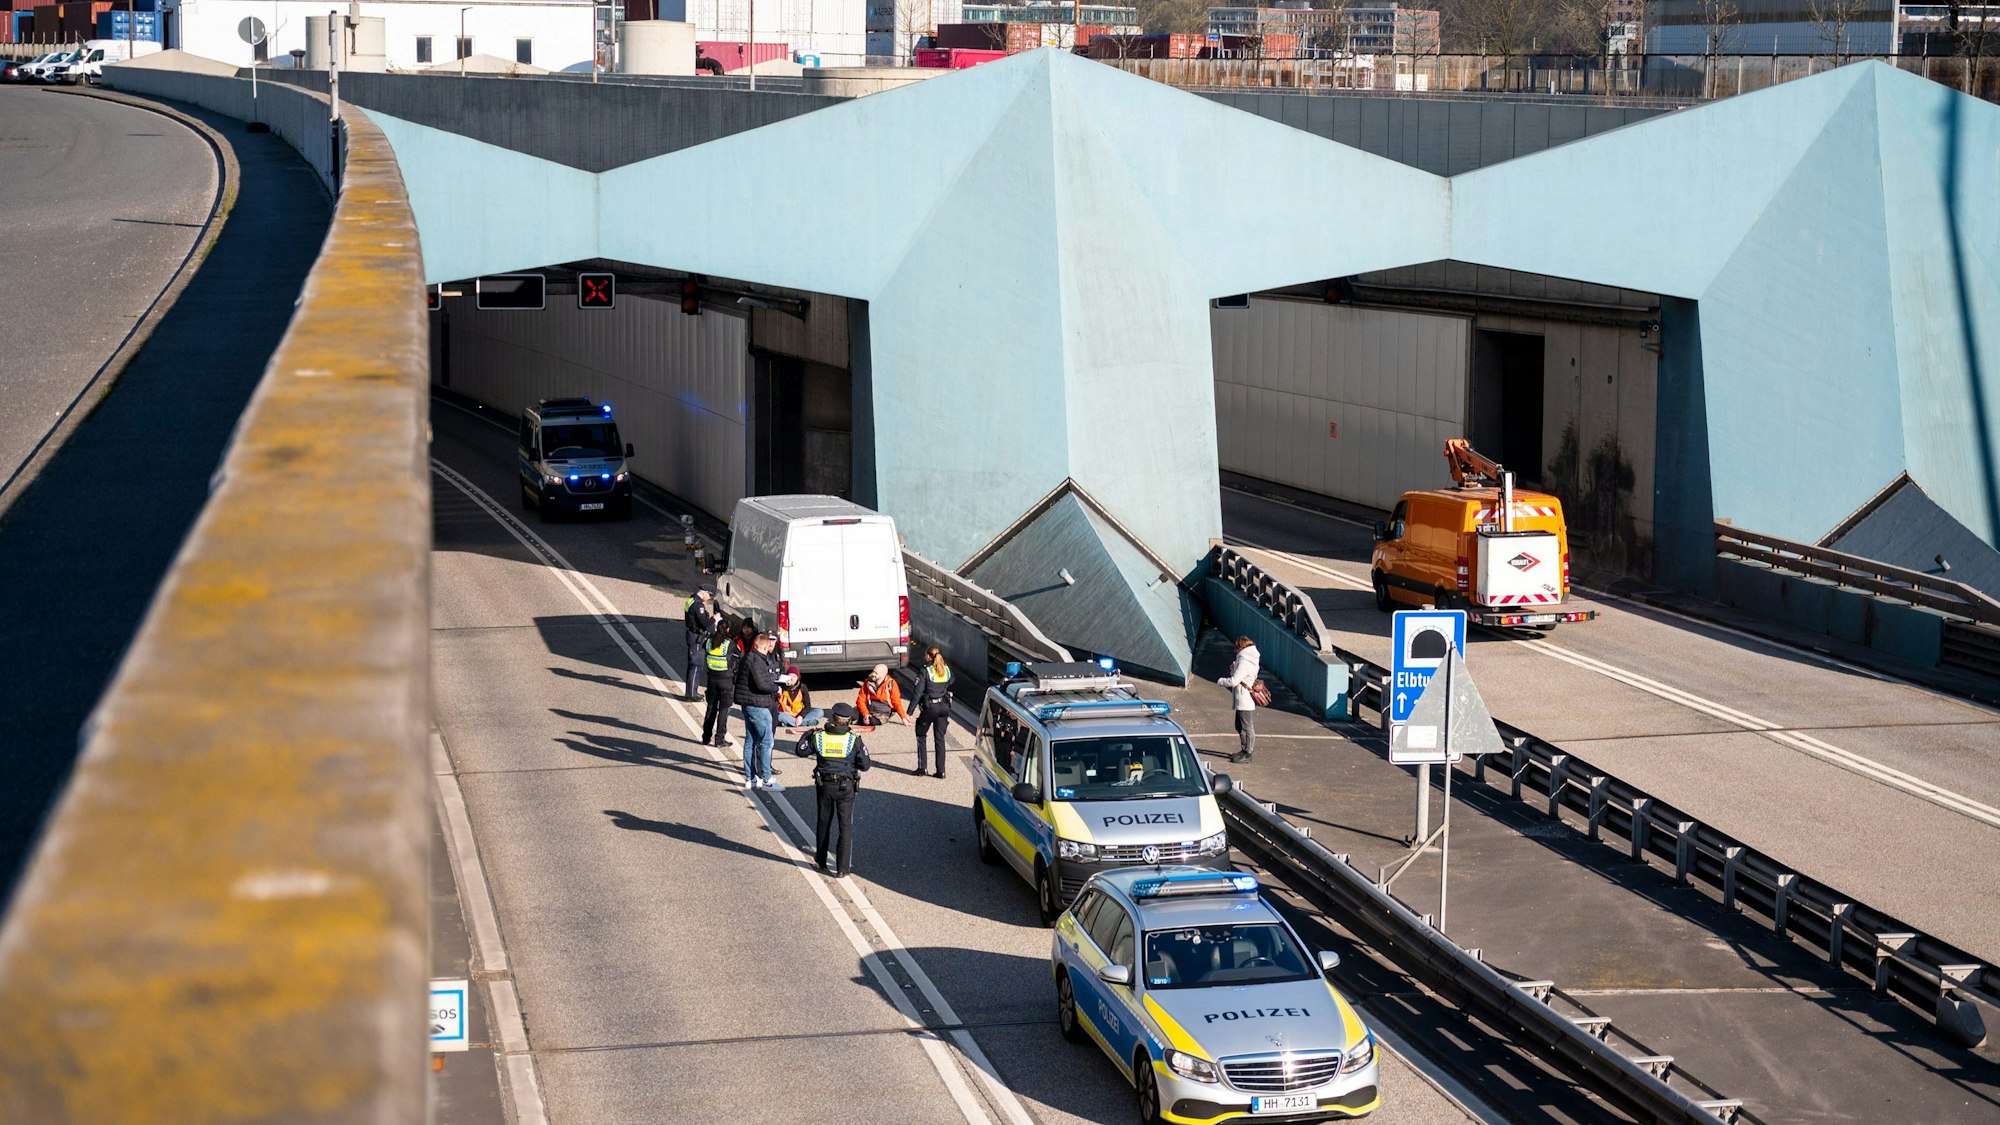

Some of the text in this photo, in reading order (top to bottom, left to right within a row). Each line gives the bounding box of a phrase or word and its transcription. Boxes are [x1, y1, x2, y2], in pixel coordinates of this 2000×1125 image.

[1103, 813, 1184, 827] POLIZEI
[1098, 998, 1120, 1036] POLIZEI
[1204, 1008, 1311, 1024] POLIZEI
[1264, 1096, 1310, 1109] HH 7131
